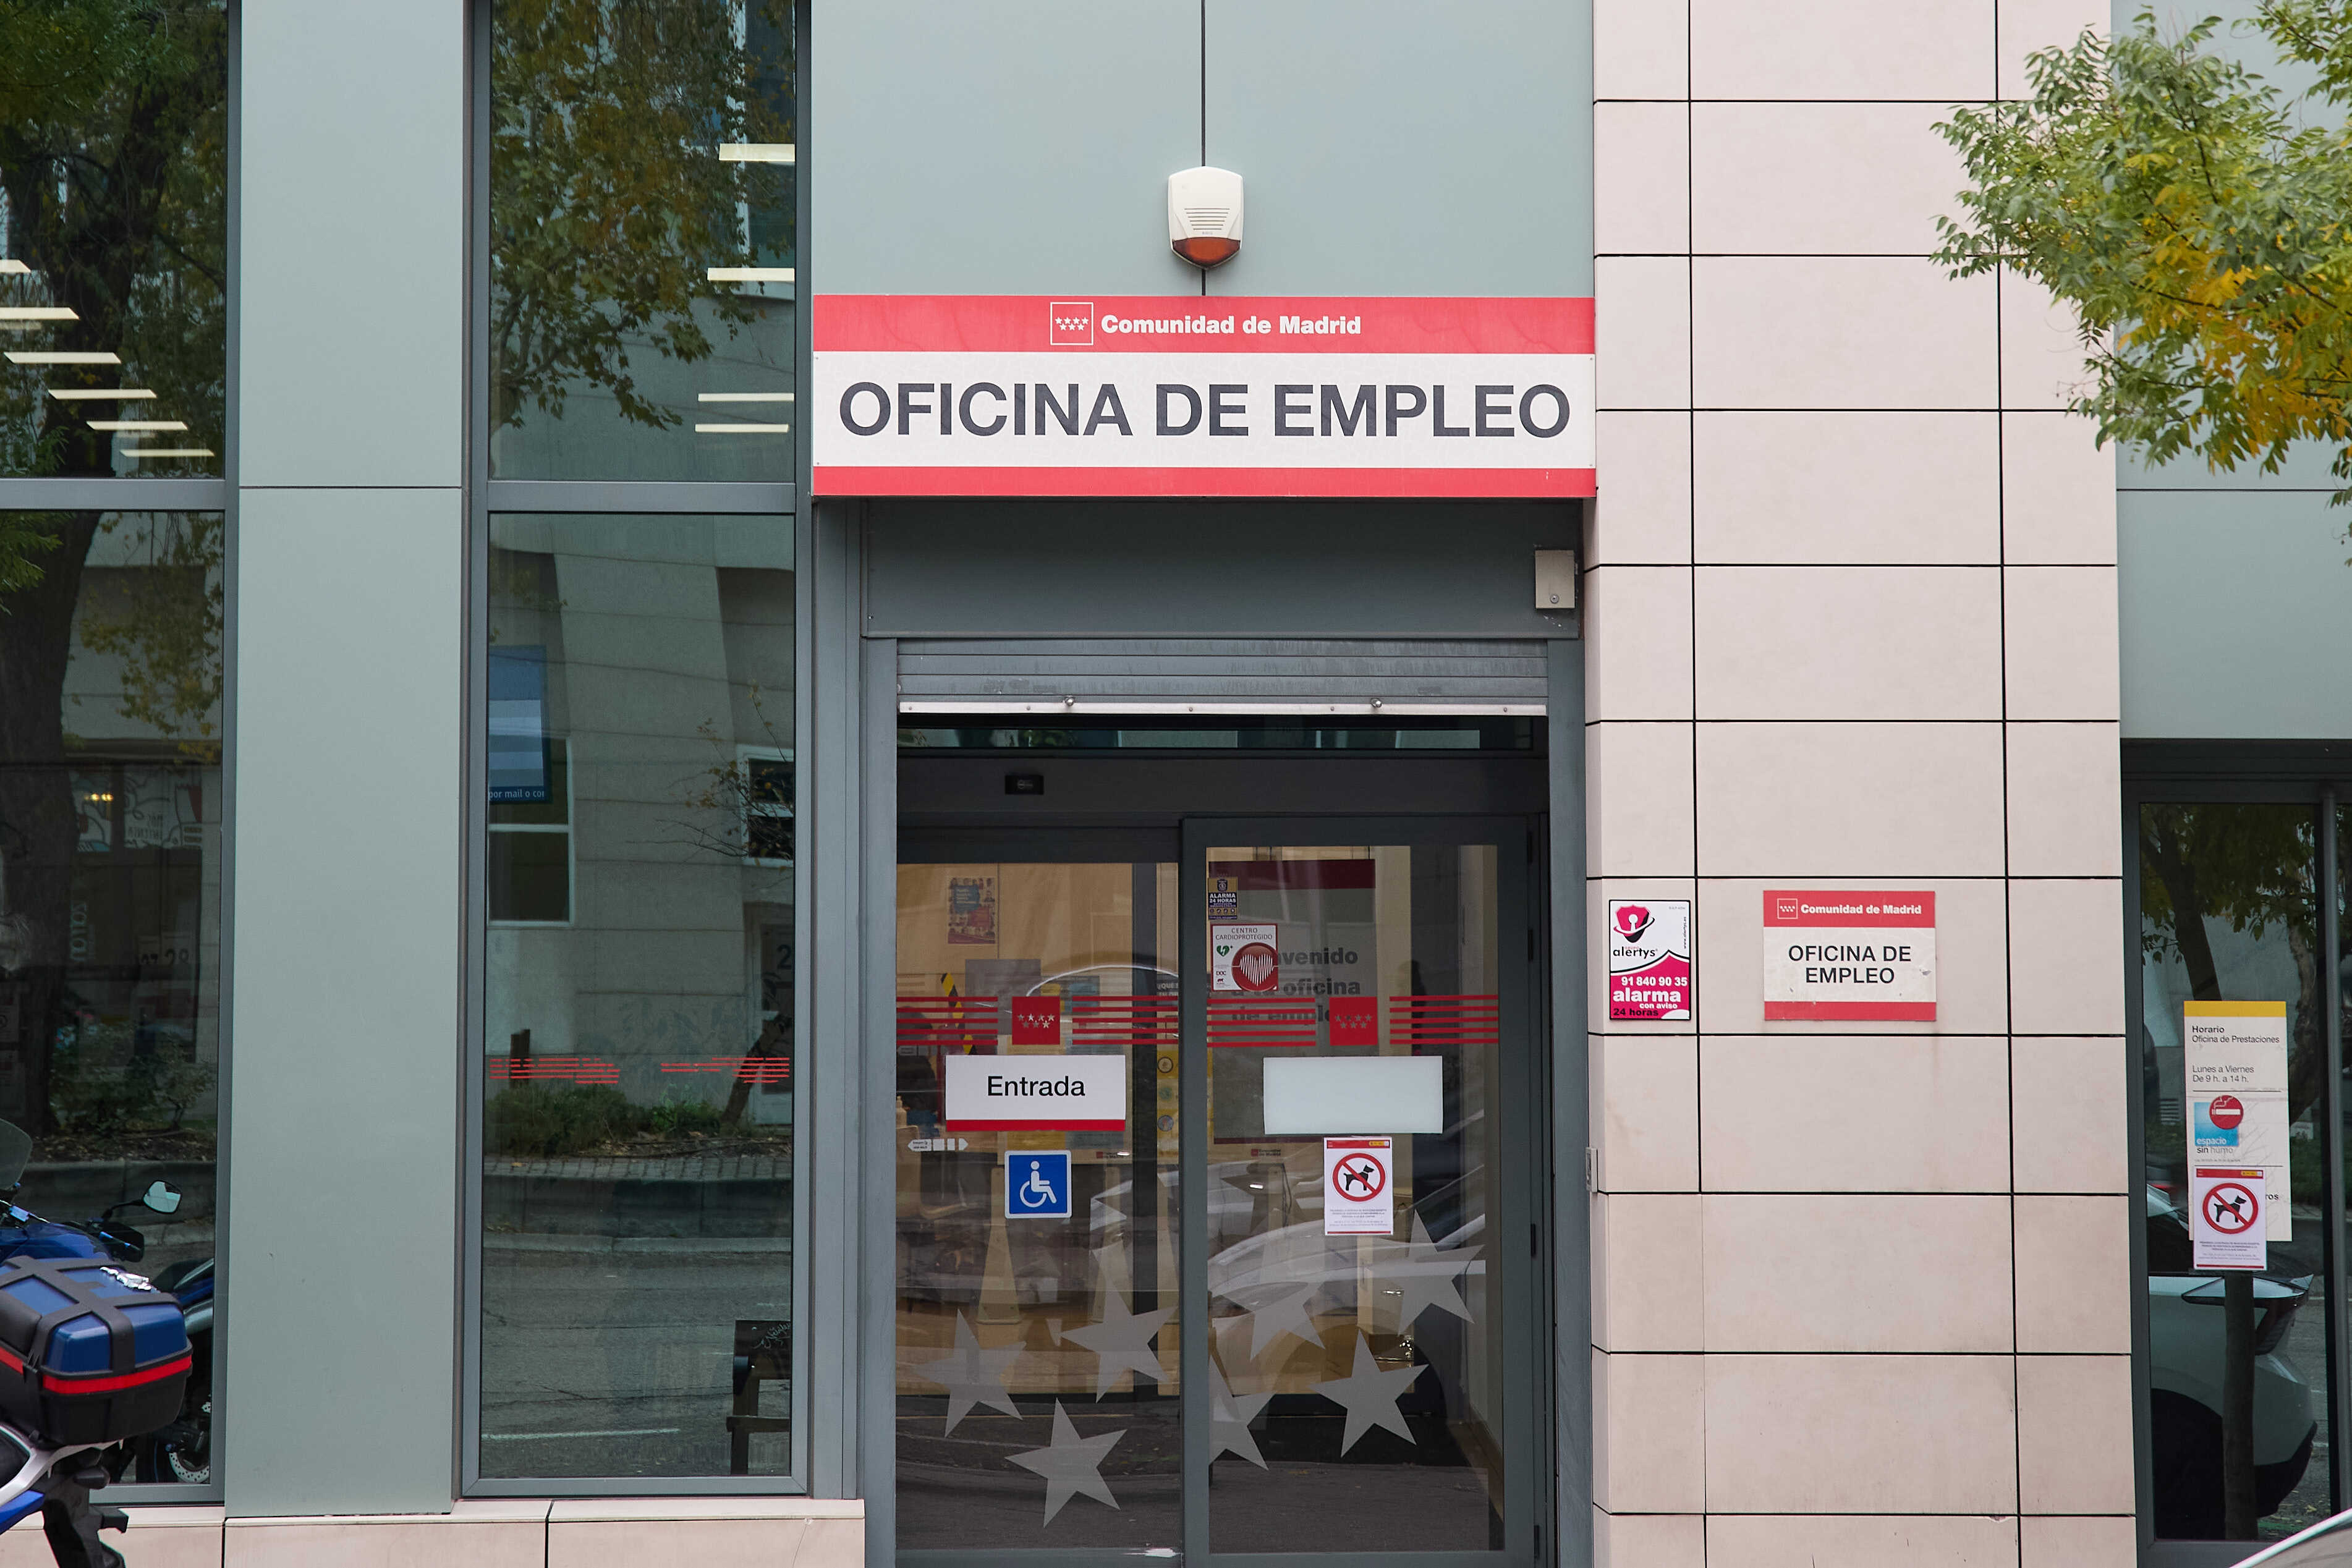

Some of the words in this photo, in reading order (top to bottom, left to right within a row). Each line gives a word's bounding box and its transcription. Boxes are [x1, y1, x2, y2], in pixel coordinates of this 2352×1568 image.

[1102, 315, 1234, 333] Comunidad
[1242, 316, 1271, 334] de
[1280, 316, 1361, 334] Madrid
[840, 382, 1132, 436] OFICINA
[1157, 384, 1249, 436] DE
[1275, 384, 1569, 438] EMPLEO
[505, 789, 522, 798] mail
[1801, 904, 1863, 913] Comunidad
[1866, 905, 1880, 913] de
[1883, 905, 1921, 913] Madrid
[1278, 947, 1358, 965] venido
[1613, 947, 1655, 959] alertys
[1789, 946, 1875, 961] OFICINA
[1883, 946, 1911, 961] DE
[1621, 977, 1633, 986] 91
[1636, 977, 1656, 986] 840
[1658, 977, 1671, 986] 90
[1675, 977, 1688, 986] 35
[1806, 968, 1894, 983] EMPLEO
[1283, 978, 1360, 995] oficina
[1613, 988, 1681, 1002] alarma
[988, 1076, 1085, 1096] Entrada
[2197, 1137, 2227, 1145] espacio
[2197, 1145, 2209, 1153] sin
[2210, 1145, 2233, 1153] humo
